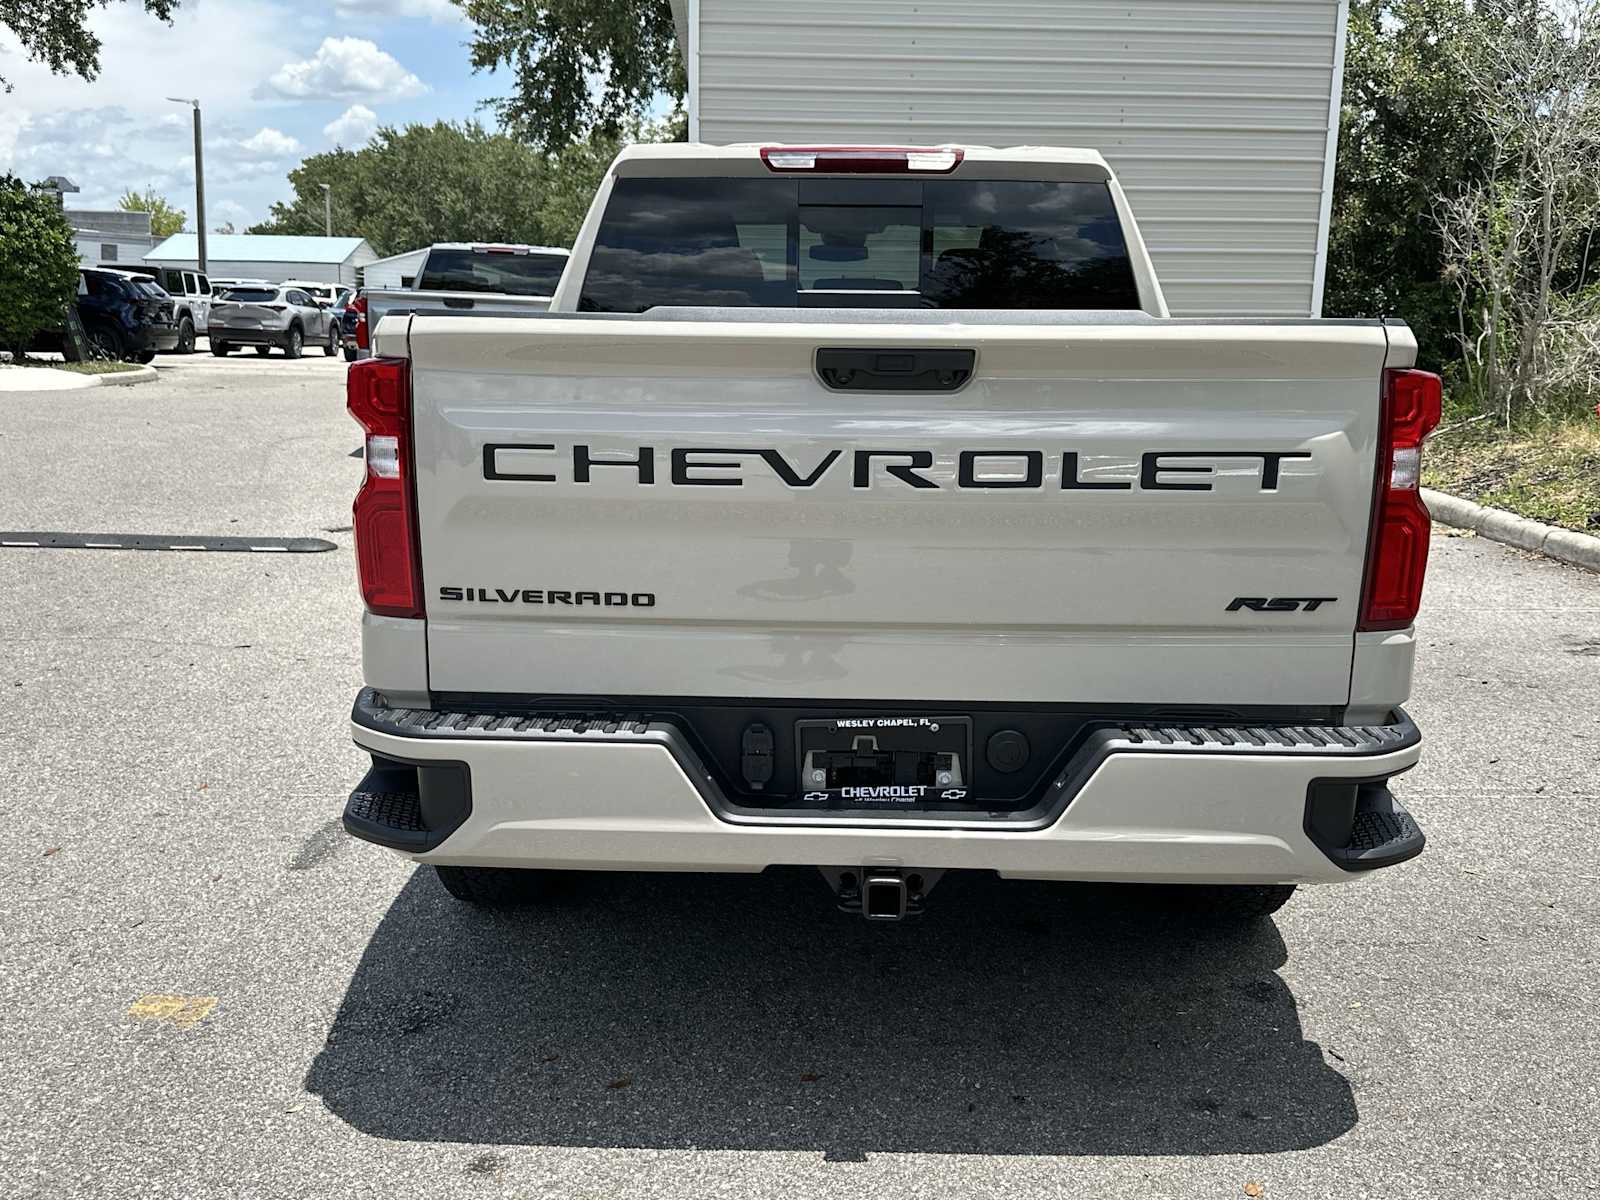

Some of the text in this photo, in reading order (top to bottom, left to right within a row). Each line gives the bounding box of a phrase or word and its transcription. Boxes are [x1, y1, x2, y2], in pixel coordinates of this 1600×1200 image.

[483, 443, 1312, 491] CHEVROLET
[439, 586, 656, 606] SILVERADO
[1224, 597, 1338, 611] RST
[836, 718, 931, 728] WESLEY CHAPEL, FL
[841, 785, 928, 798] CHEVROLET
